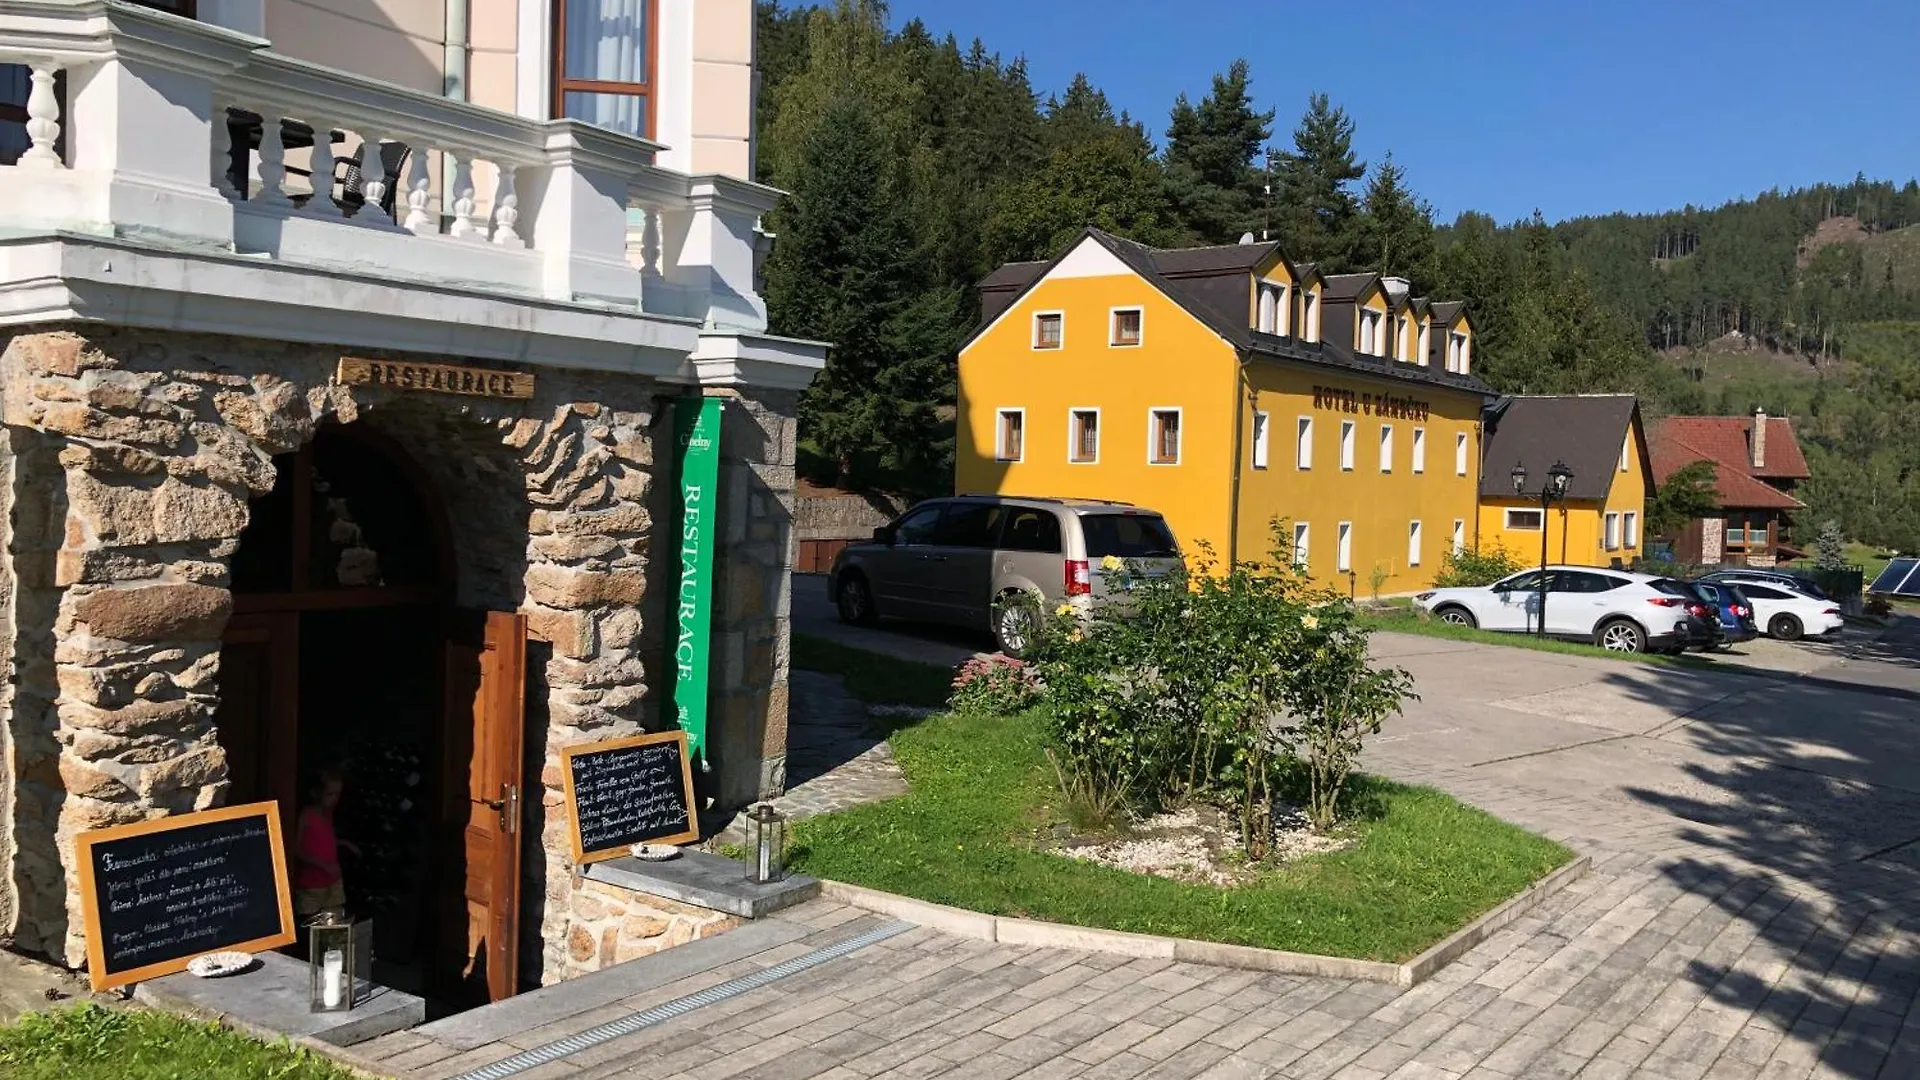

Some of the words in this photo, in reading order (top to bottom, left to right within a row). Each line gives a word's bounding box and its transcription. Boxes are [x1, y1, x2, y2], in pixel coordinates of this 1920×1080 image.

[369, 363, 514, 394] RESTAURACE
[1312, 385, 1358, 414] HOTEL
[676, 484, 700, 681] RESTAURACE
